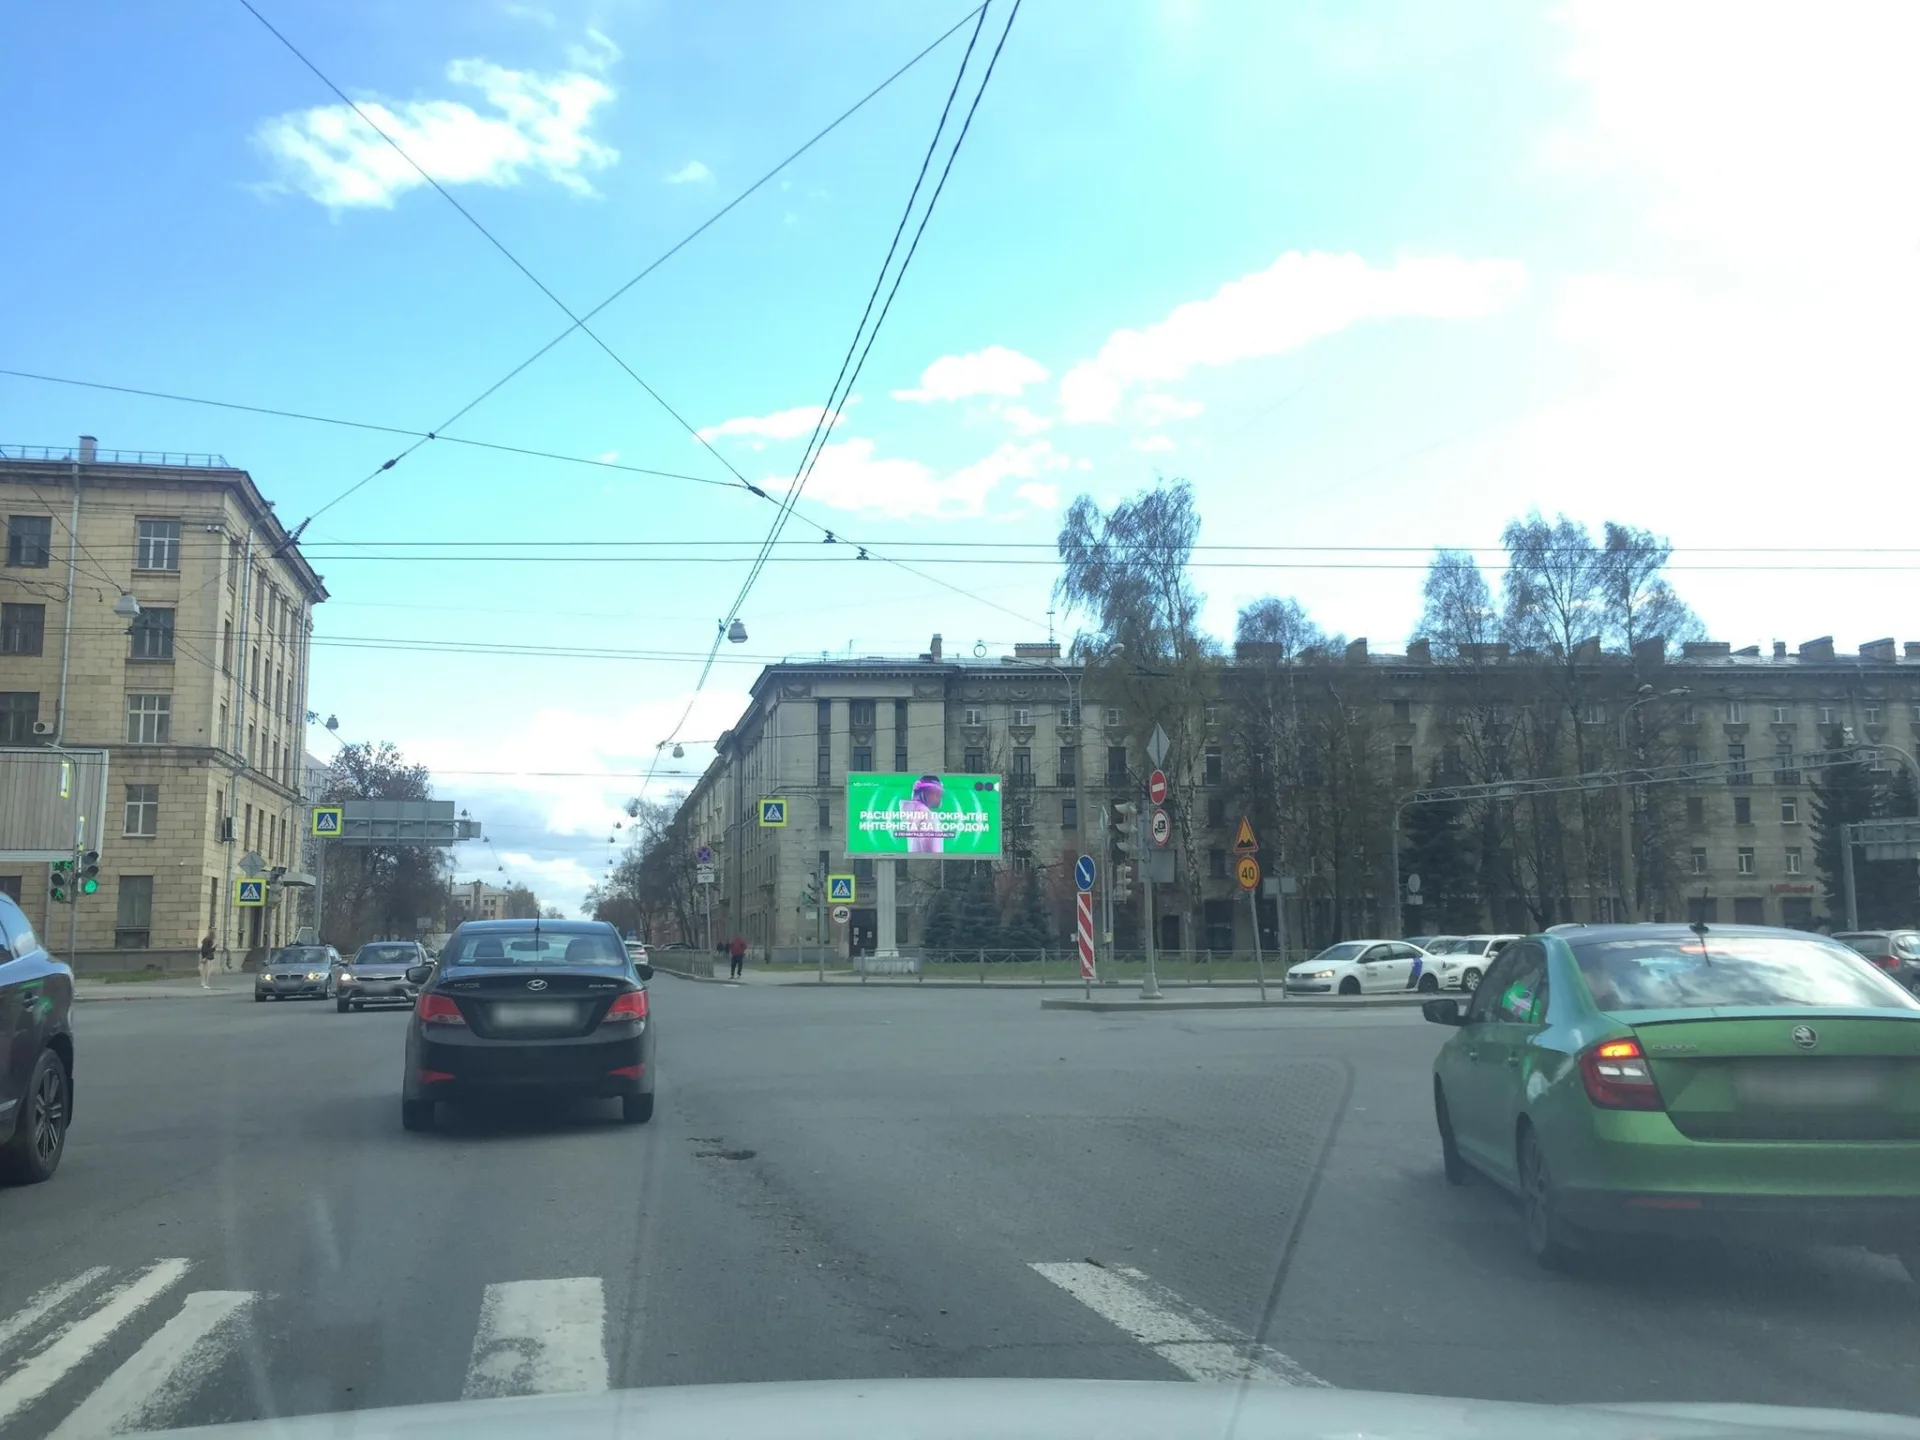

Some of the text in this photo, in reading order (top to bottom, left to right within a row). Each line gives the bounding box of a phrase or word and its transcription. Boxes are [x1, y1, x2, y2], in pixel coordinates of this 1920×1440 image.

[860, 811, 988, 821] РАСШИРИЛИ ПОКРЫТИЕ
[859, 821, 989, 832] ИНТЕРНЕТА ЗА ГОРОДОМ
[1241, 866, 1255, 880] 40
